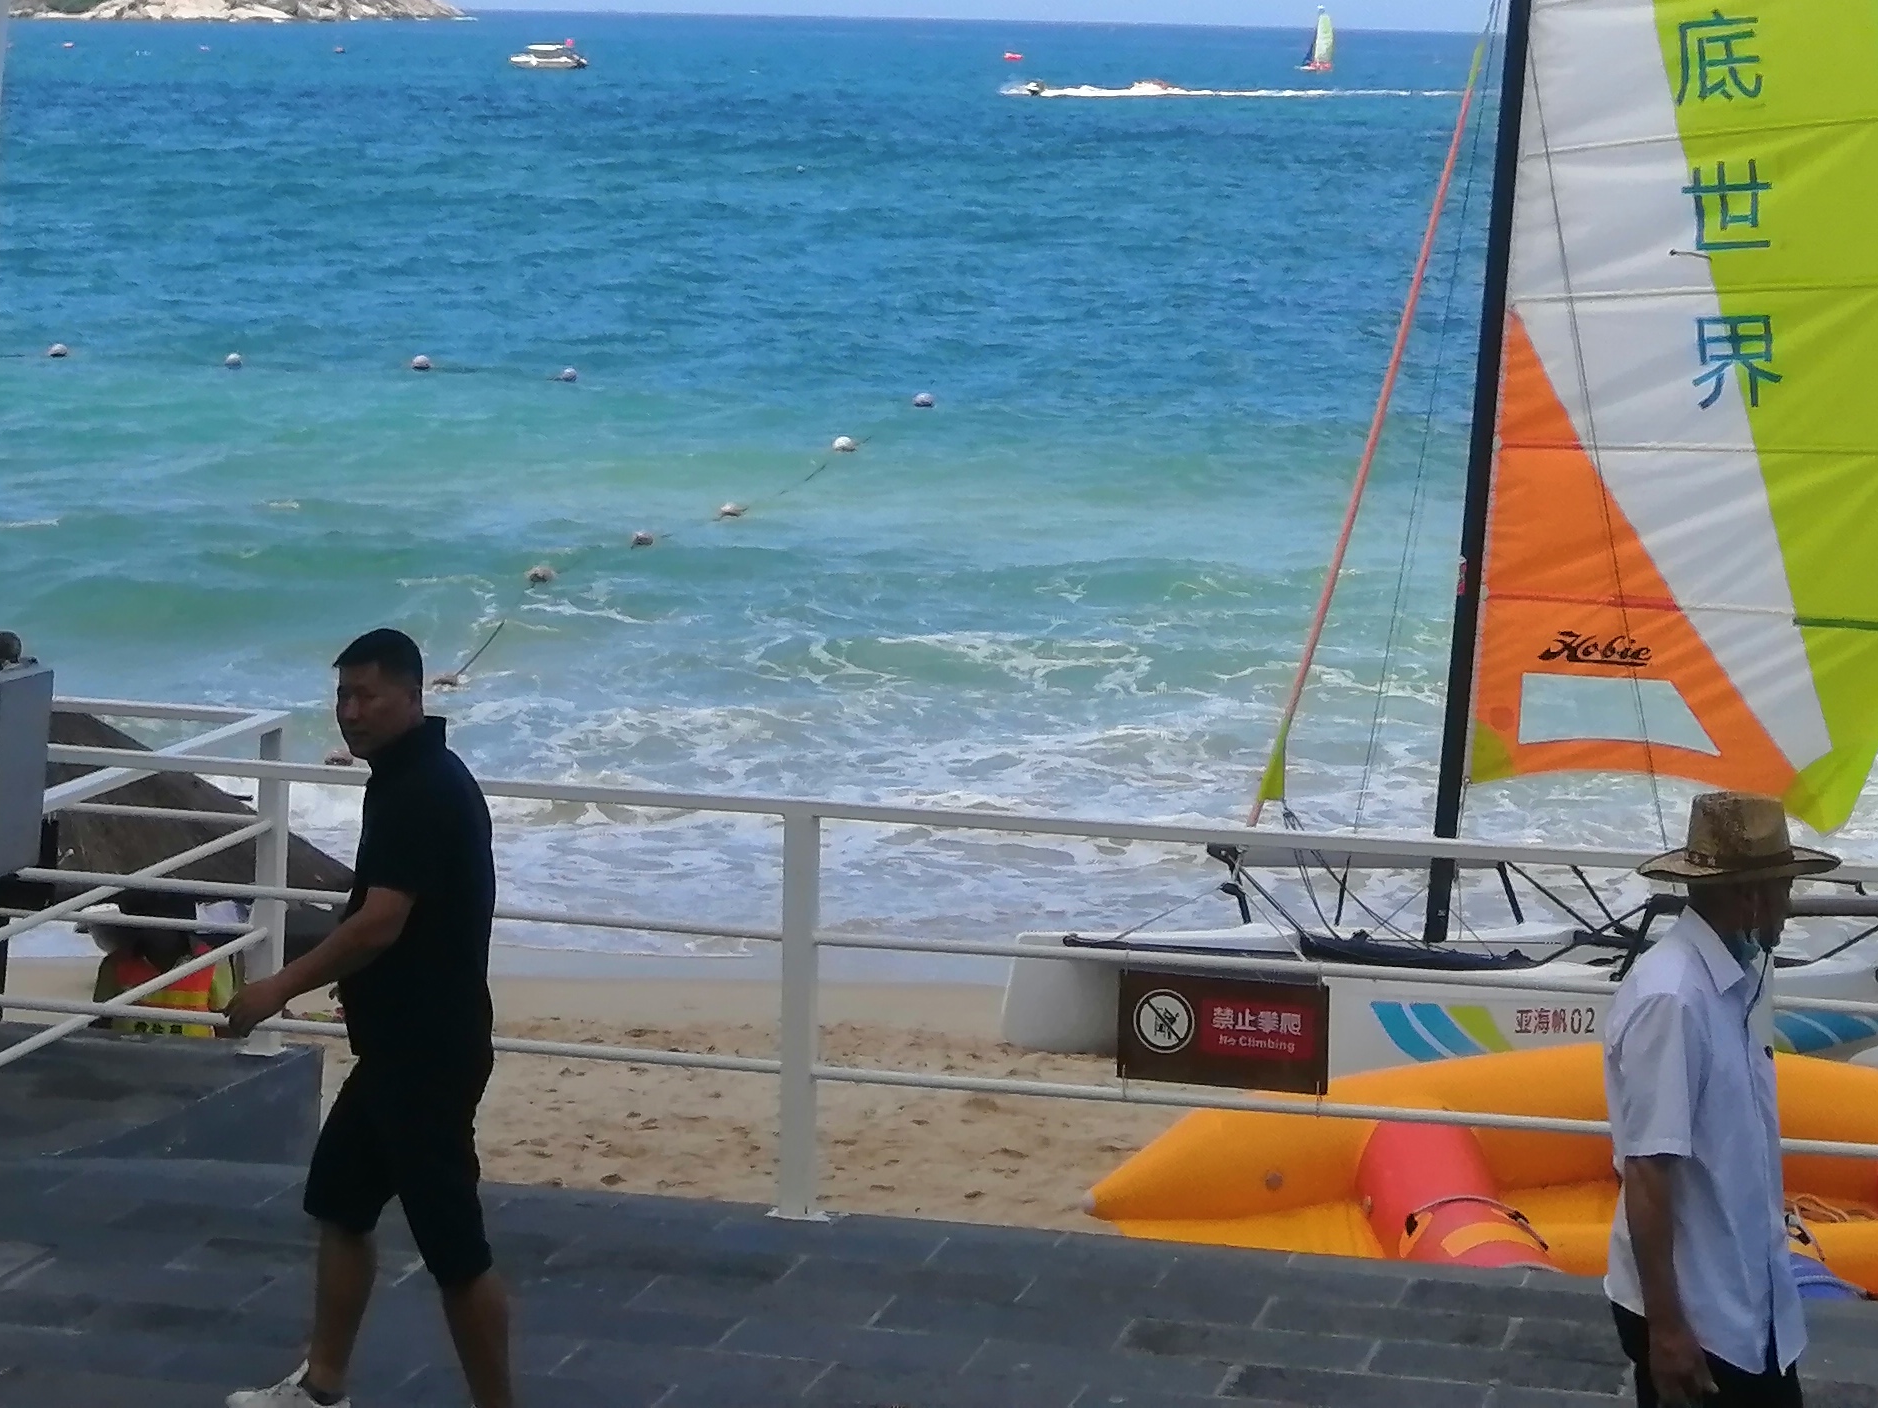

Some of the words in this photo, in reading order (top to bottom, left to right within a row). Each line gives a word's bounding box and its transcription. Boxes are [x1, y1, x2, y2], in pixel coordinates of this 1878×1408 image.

[1538, 630, 1652, 667] Hobie
[1219, 1033, 1236, 1046] No
[1238, 1035, 1295, 1054] Climbing
